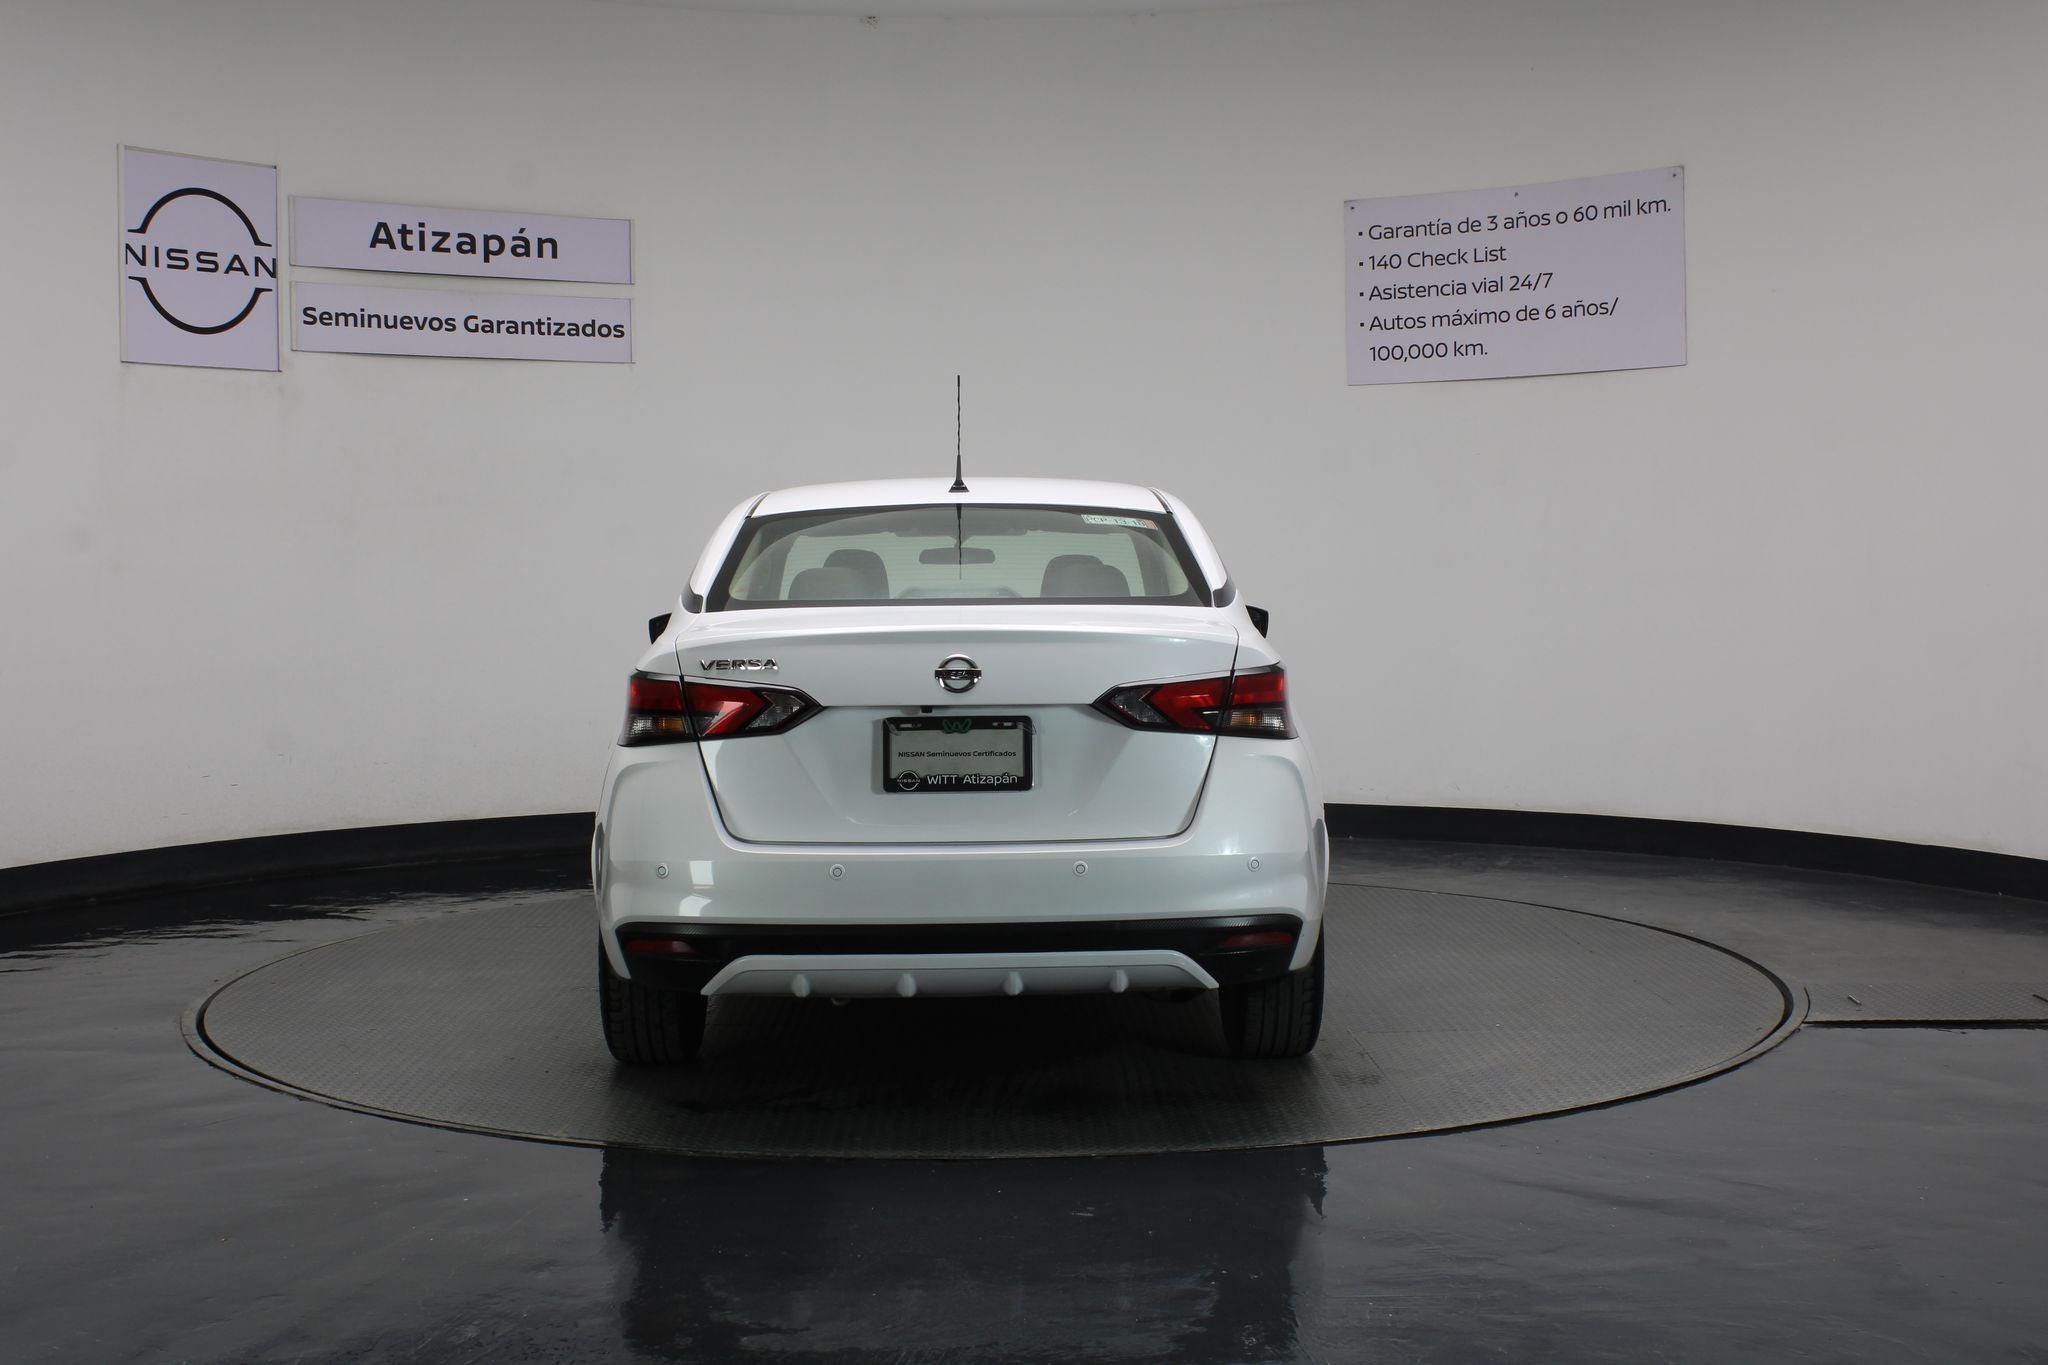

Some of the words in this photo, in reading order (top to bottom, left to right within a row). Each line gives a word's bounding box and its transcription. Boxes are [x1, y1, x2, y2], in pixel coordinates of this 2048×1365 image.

[1368, 218, 1451, 240] Garantía
[1457, 216, 1482, 234] de
[1486, 215, 1499, 231] 3
[1504, 211, 1552, 230] años
[1556, 210, 1569, 225] o
[1573, 205, 1599, 222] 60
[1604, 199, 1632, 219] mil
[1637, 197, 1672, 216] km.
[369, 221, 558, 263] Atizapán
[125, 243, 276, 279] NISSAN
[1369, 253, 1402, 270] 140
[1407, 249, 1469, 268] Check
[1473, 246, 1507, 264] List
[1369, 283, 1467, 301] Asistencia
[1472, 276, 1504, 294] vial
[1509, 272, 1553, 292] 24/7
[302, 306, 457, 332] Seminuevos
[464, 315, 625, 338] Garantizados
[1369, 315, 1427, 332] Autos
[1432, 309, 1511, 328] máximo
[1516, 304, 1540, 322] de
[1544, 303, 1557, 320] 6
[1562, 297, 1618, 319] años/
[1369, 342, 1448, 362] 100,000
[1454, 340, 1488, 357] km.
[700, 658, 778, 670] VERSA
[926, 775, 958, 785] WITT
[963, 773, 1018, 786] Atizapán
